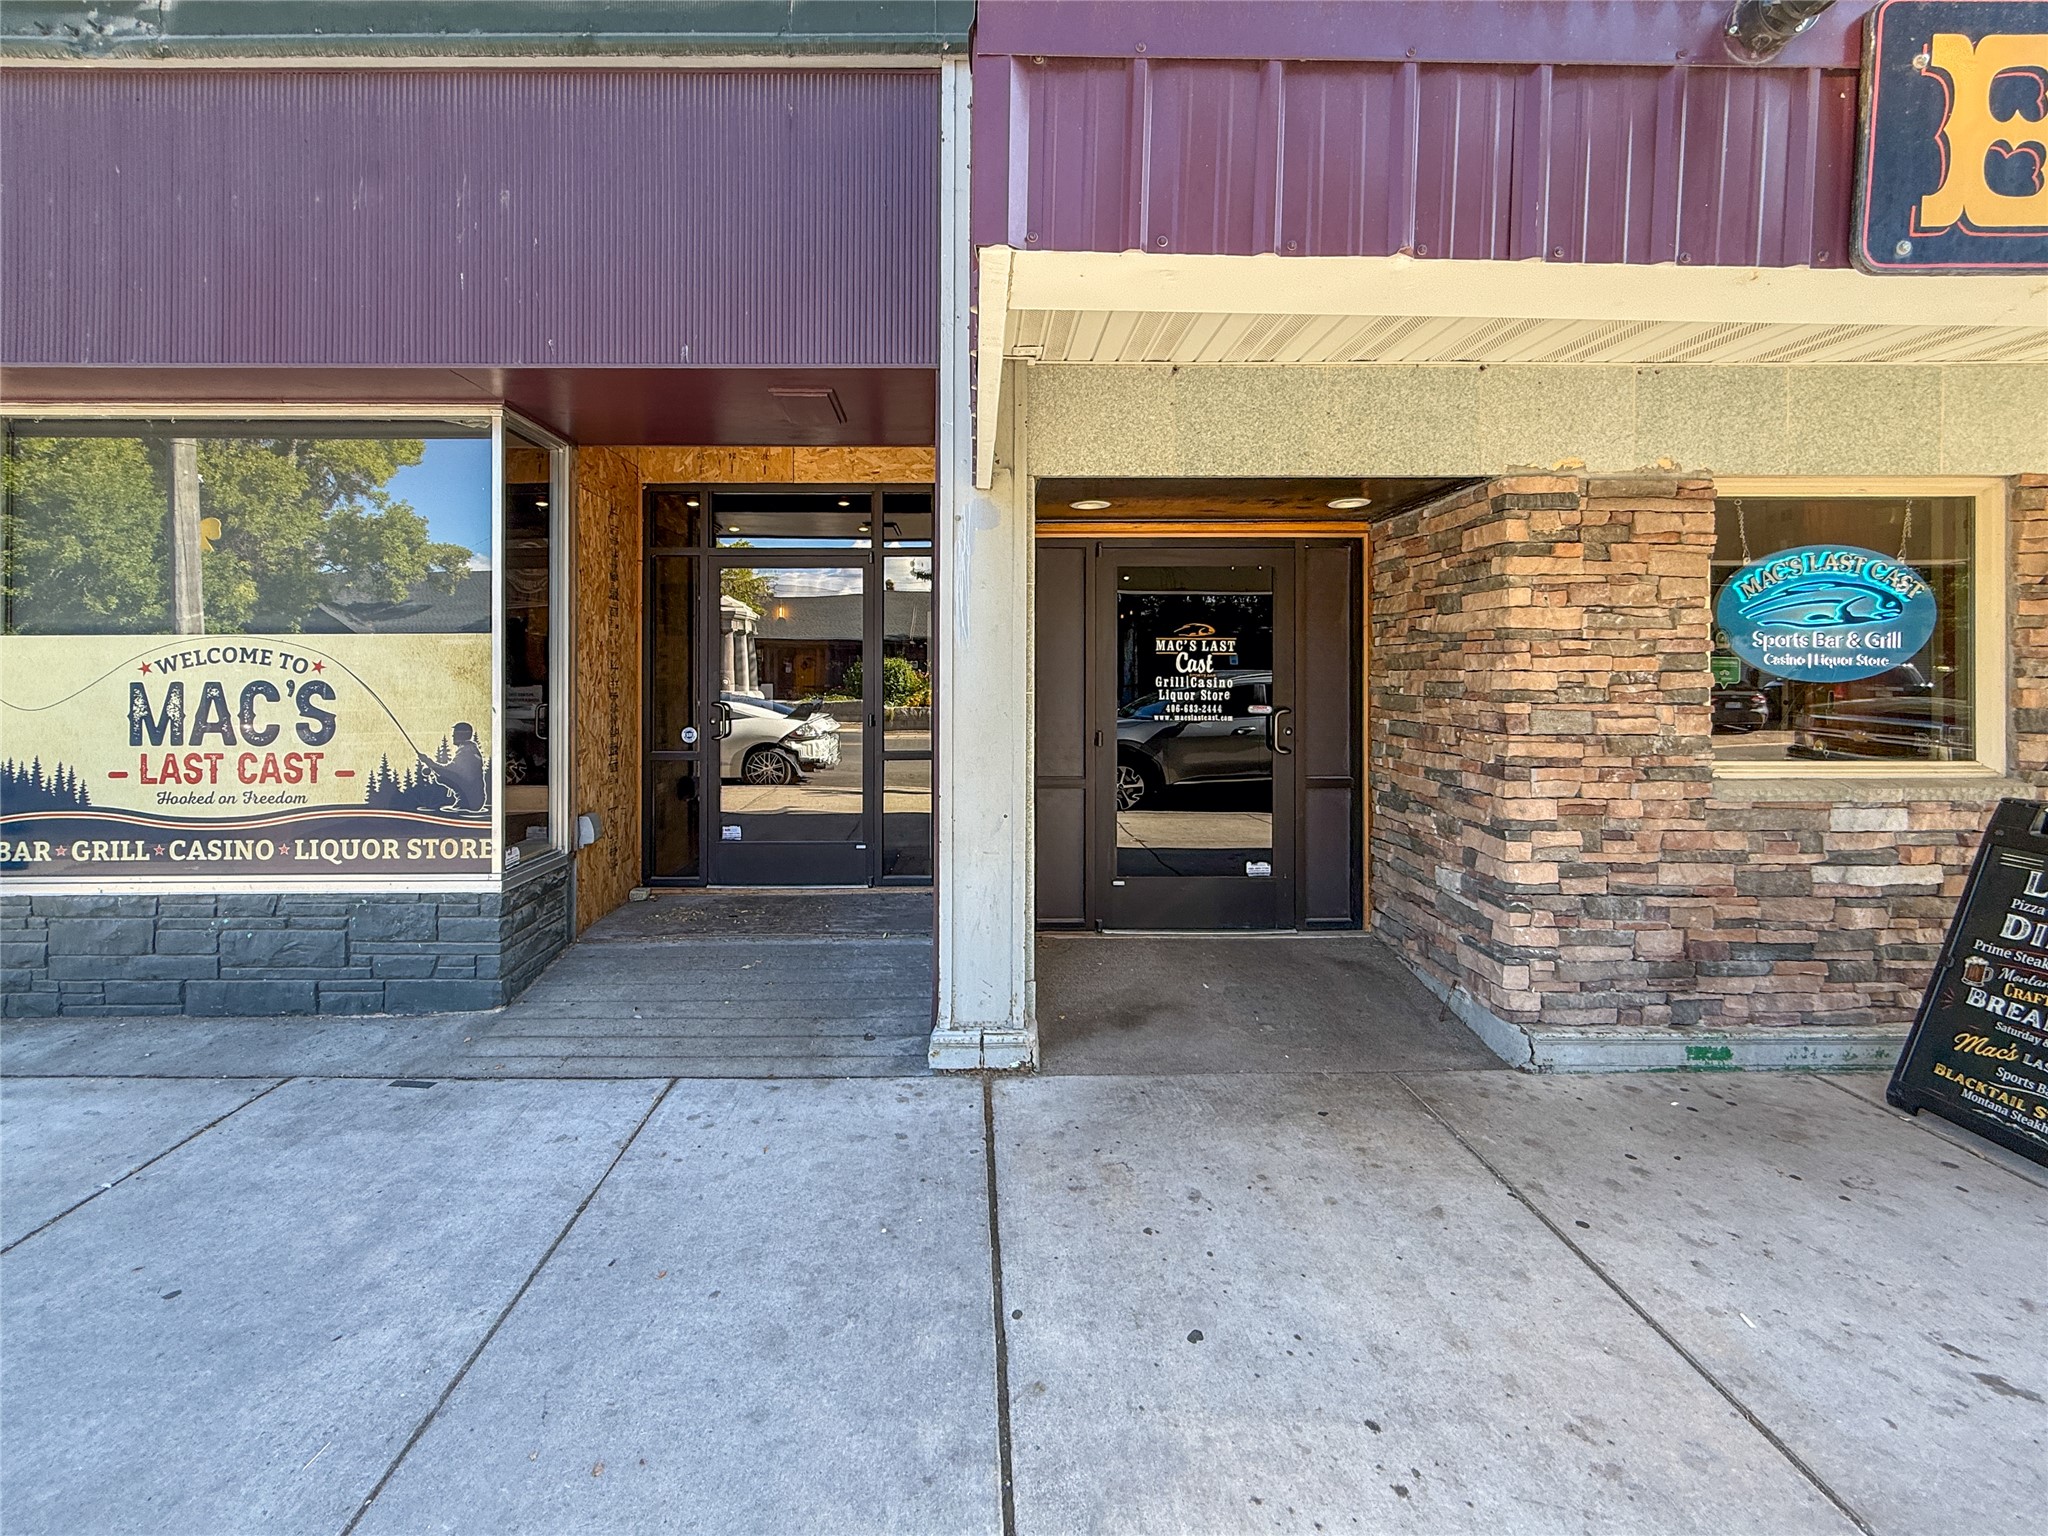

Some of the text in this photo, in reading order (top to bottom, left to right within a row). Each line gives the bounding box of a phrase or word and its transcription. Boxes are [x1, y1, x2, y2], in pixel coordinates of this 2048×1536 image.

[1738, 553, 1926, 600] MAC'S LAST CAST
[1155, 640, 1236, 652] MAC'S LAST
[1752, 631, 1902, 651] Sports Bar & Grill
[154, 647, 309, 675] WELCOME TO
[1175, 652, 1214, 673] Cast
[1763, 653, 1806, 667] Casino
[1814, 653, 1853, 669] Liquor
[1856, 653, 1890, 667] Store
[1158, 689, 1231, 702] Liquor Store
[127, 679, 337, 747] MAC'S
[140, 752, 324, 785] LAST CAST
[157, 791, 308, 805] Hooked on Freedom
[0, 840, 52, 862] BAR
[71, 840, 150, 862] GRILL
[168, 839, 274, 861] CASINO
[294, 838, 400, 865] LIQUOR
[407, 838, 492, 860] STORE
[2010, 898, 2046, 917] Pizza
[1999, 913, 2048, 950] DI
[1973, 939, 2012, 958] Prime
[1965, 987, 2048, 1032] BREA
[1953, 1032, 2019, 1061] Mac's
[1995, 1021, 2041, 1046] Saturday
[1933, 1062, 2048, 1120] BLACKTAIL S
[1995, 1066, 2036, 1090] Sports
[1960, 1088, 2009, 1116] Montana
